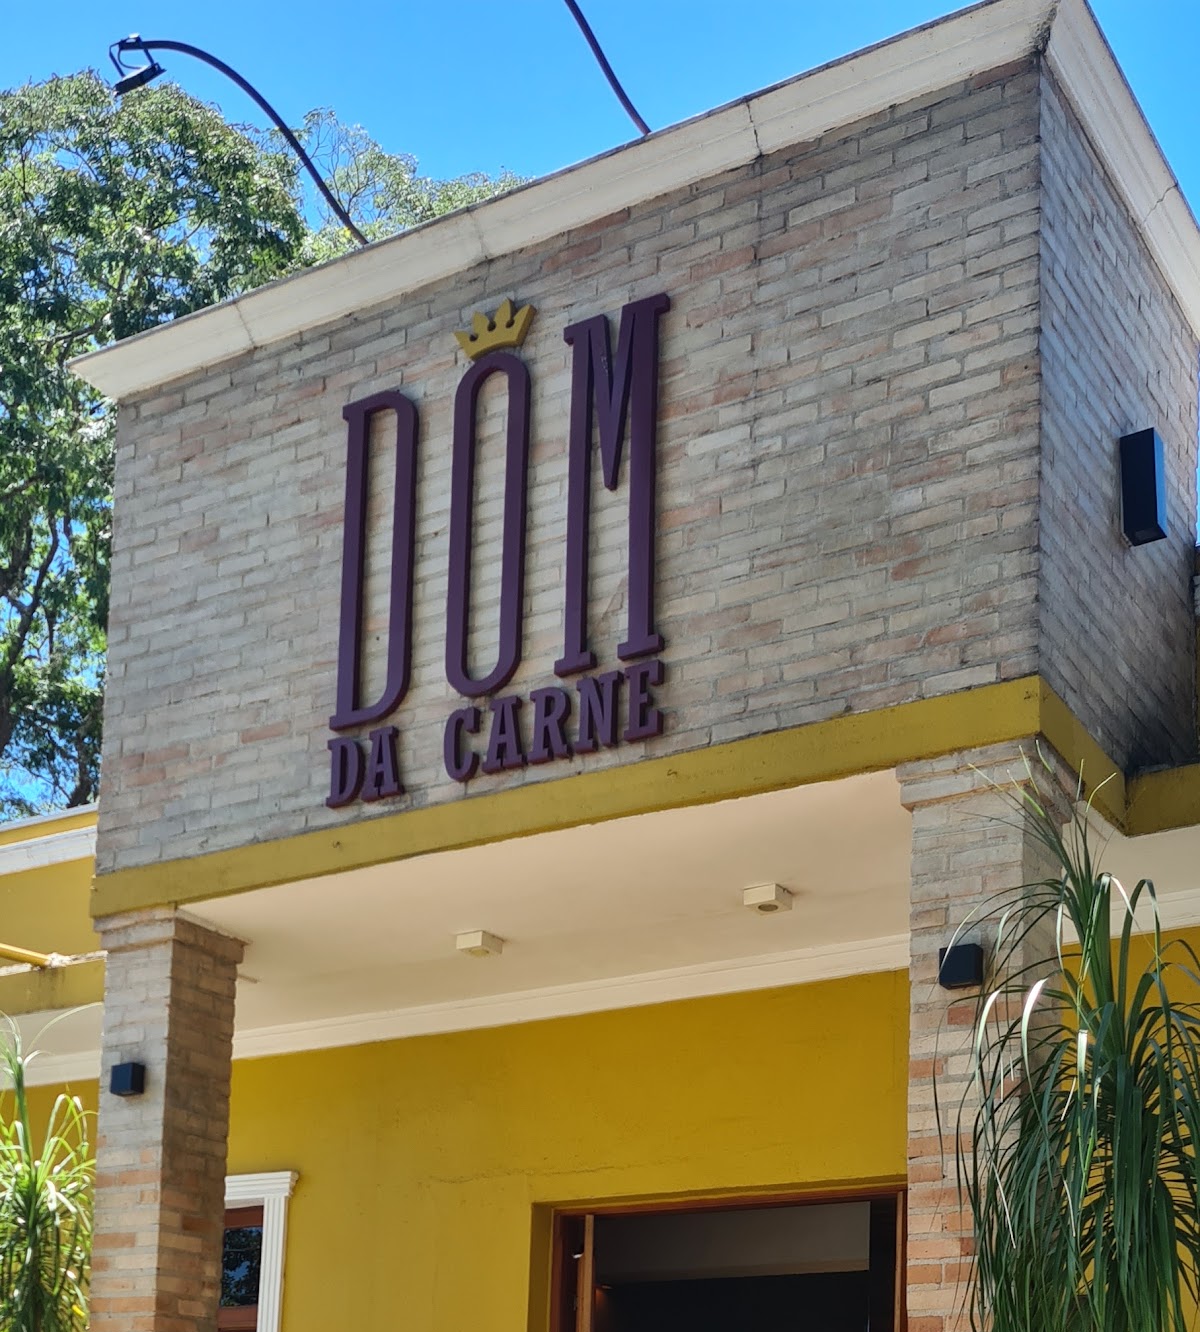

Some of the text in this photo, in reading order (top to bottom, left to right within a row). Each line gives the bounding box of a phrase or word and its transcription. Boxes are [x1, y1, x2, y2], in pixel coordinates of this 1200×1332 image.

[329, 293, 670, 731] DOM
[326, 659, 664, 809] DA CARNE
